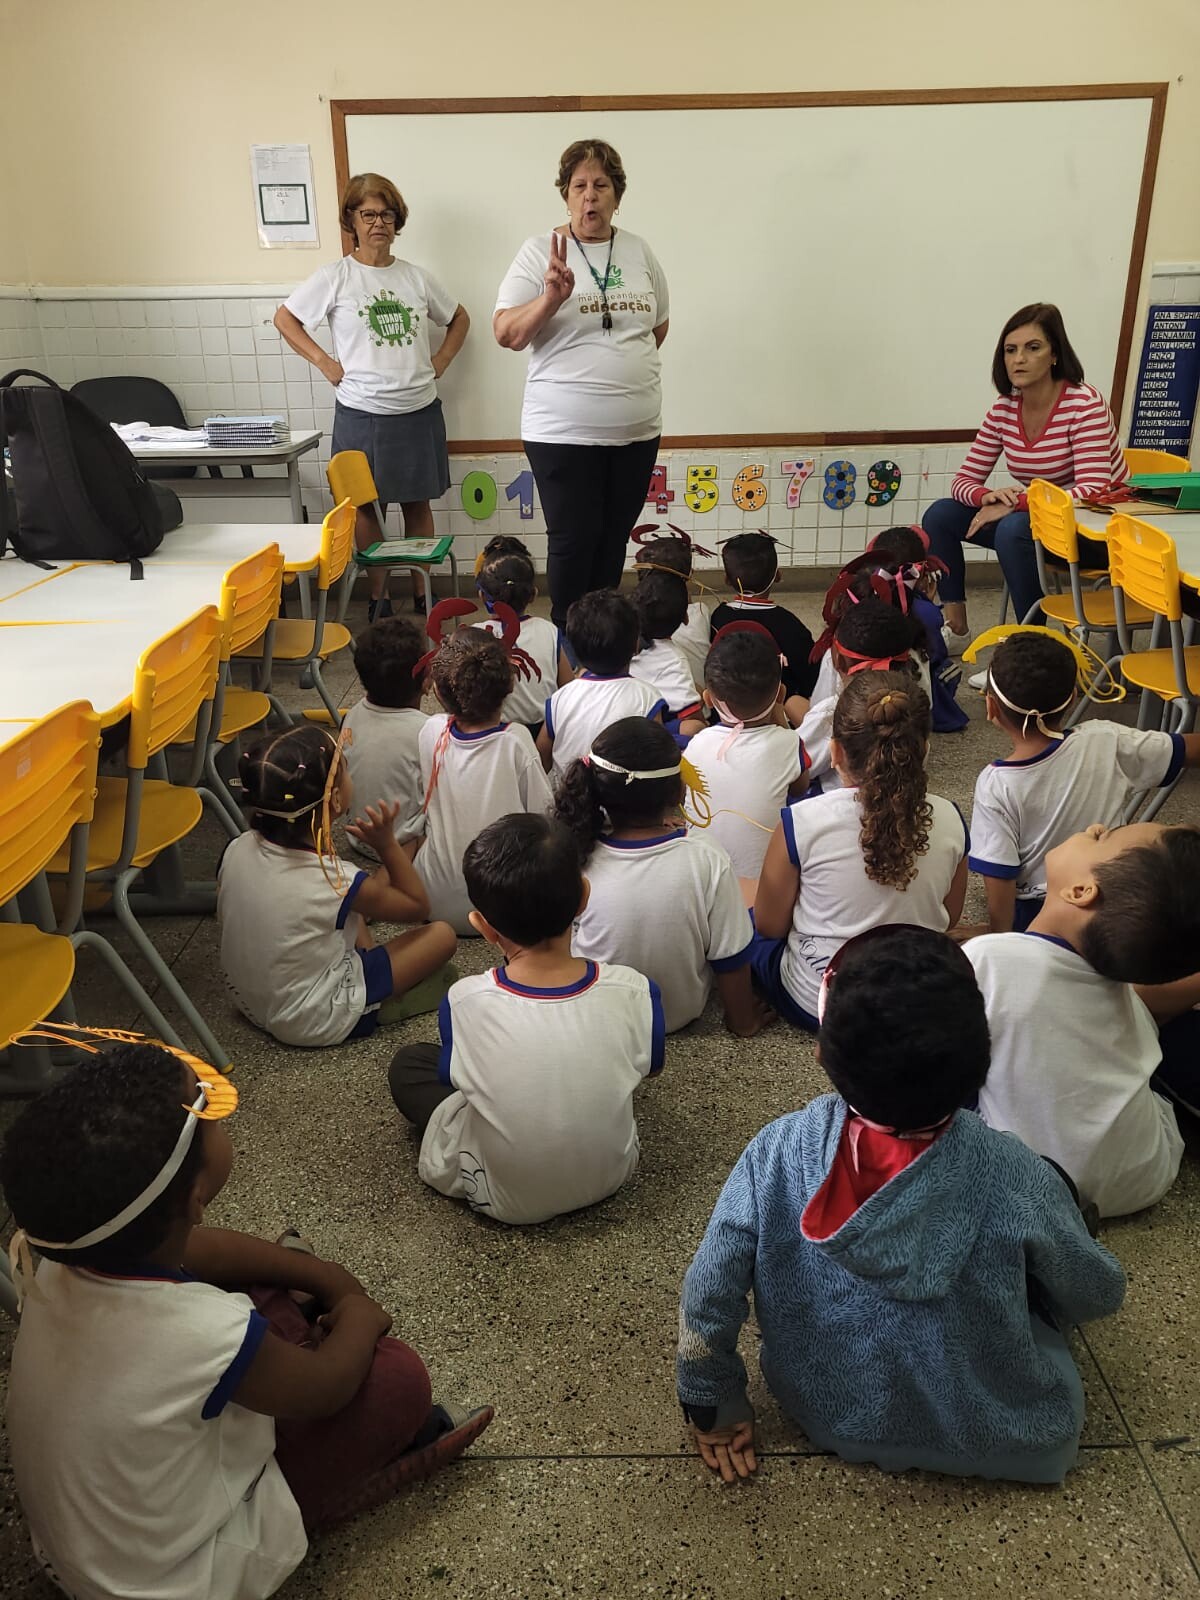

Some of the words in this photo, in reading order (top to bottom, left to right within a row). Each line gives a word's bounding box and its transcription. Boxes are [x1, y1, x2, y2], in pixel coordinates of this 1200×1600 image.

[380, 322, 405, 337] LIMPA
[1151, 331, 1194, 340] BENJAMIM
[1153, 321, 1185, 330] ANTONY
[1154, 311, 1171, 320] ANA
[1150, 351, 1172, 360] ENZO
[461, 470, 497, 520] 0
[505, 470, 533, 519] 1
[644, 465, 674, 514] 4
[684, 465, 719, 513] 5
[732, 465, 767, 511] 6
[781, 459, 815, 509] 7
[823, 460, 856, 510] 8
[865, 460, 901, 507] 9
